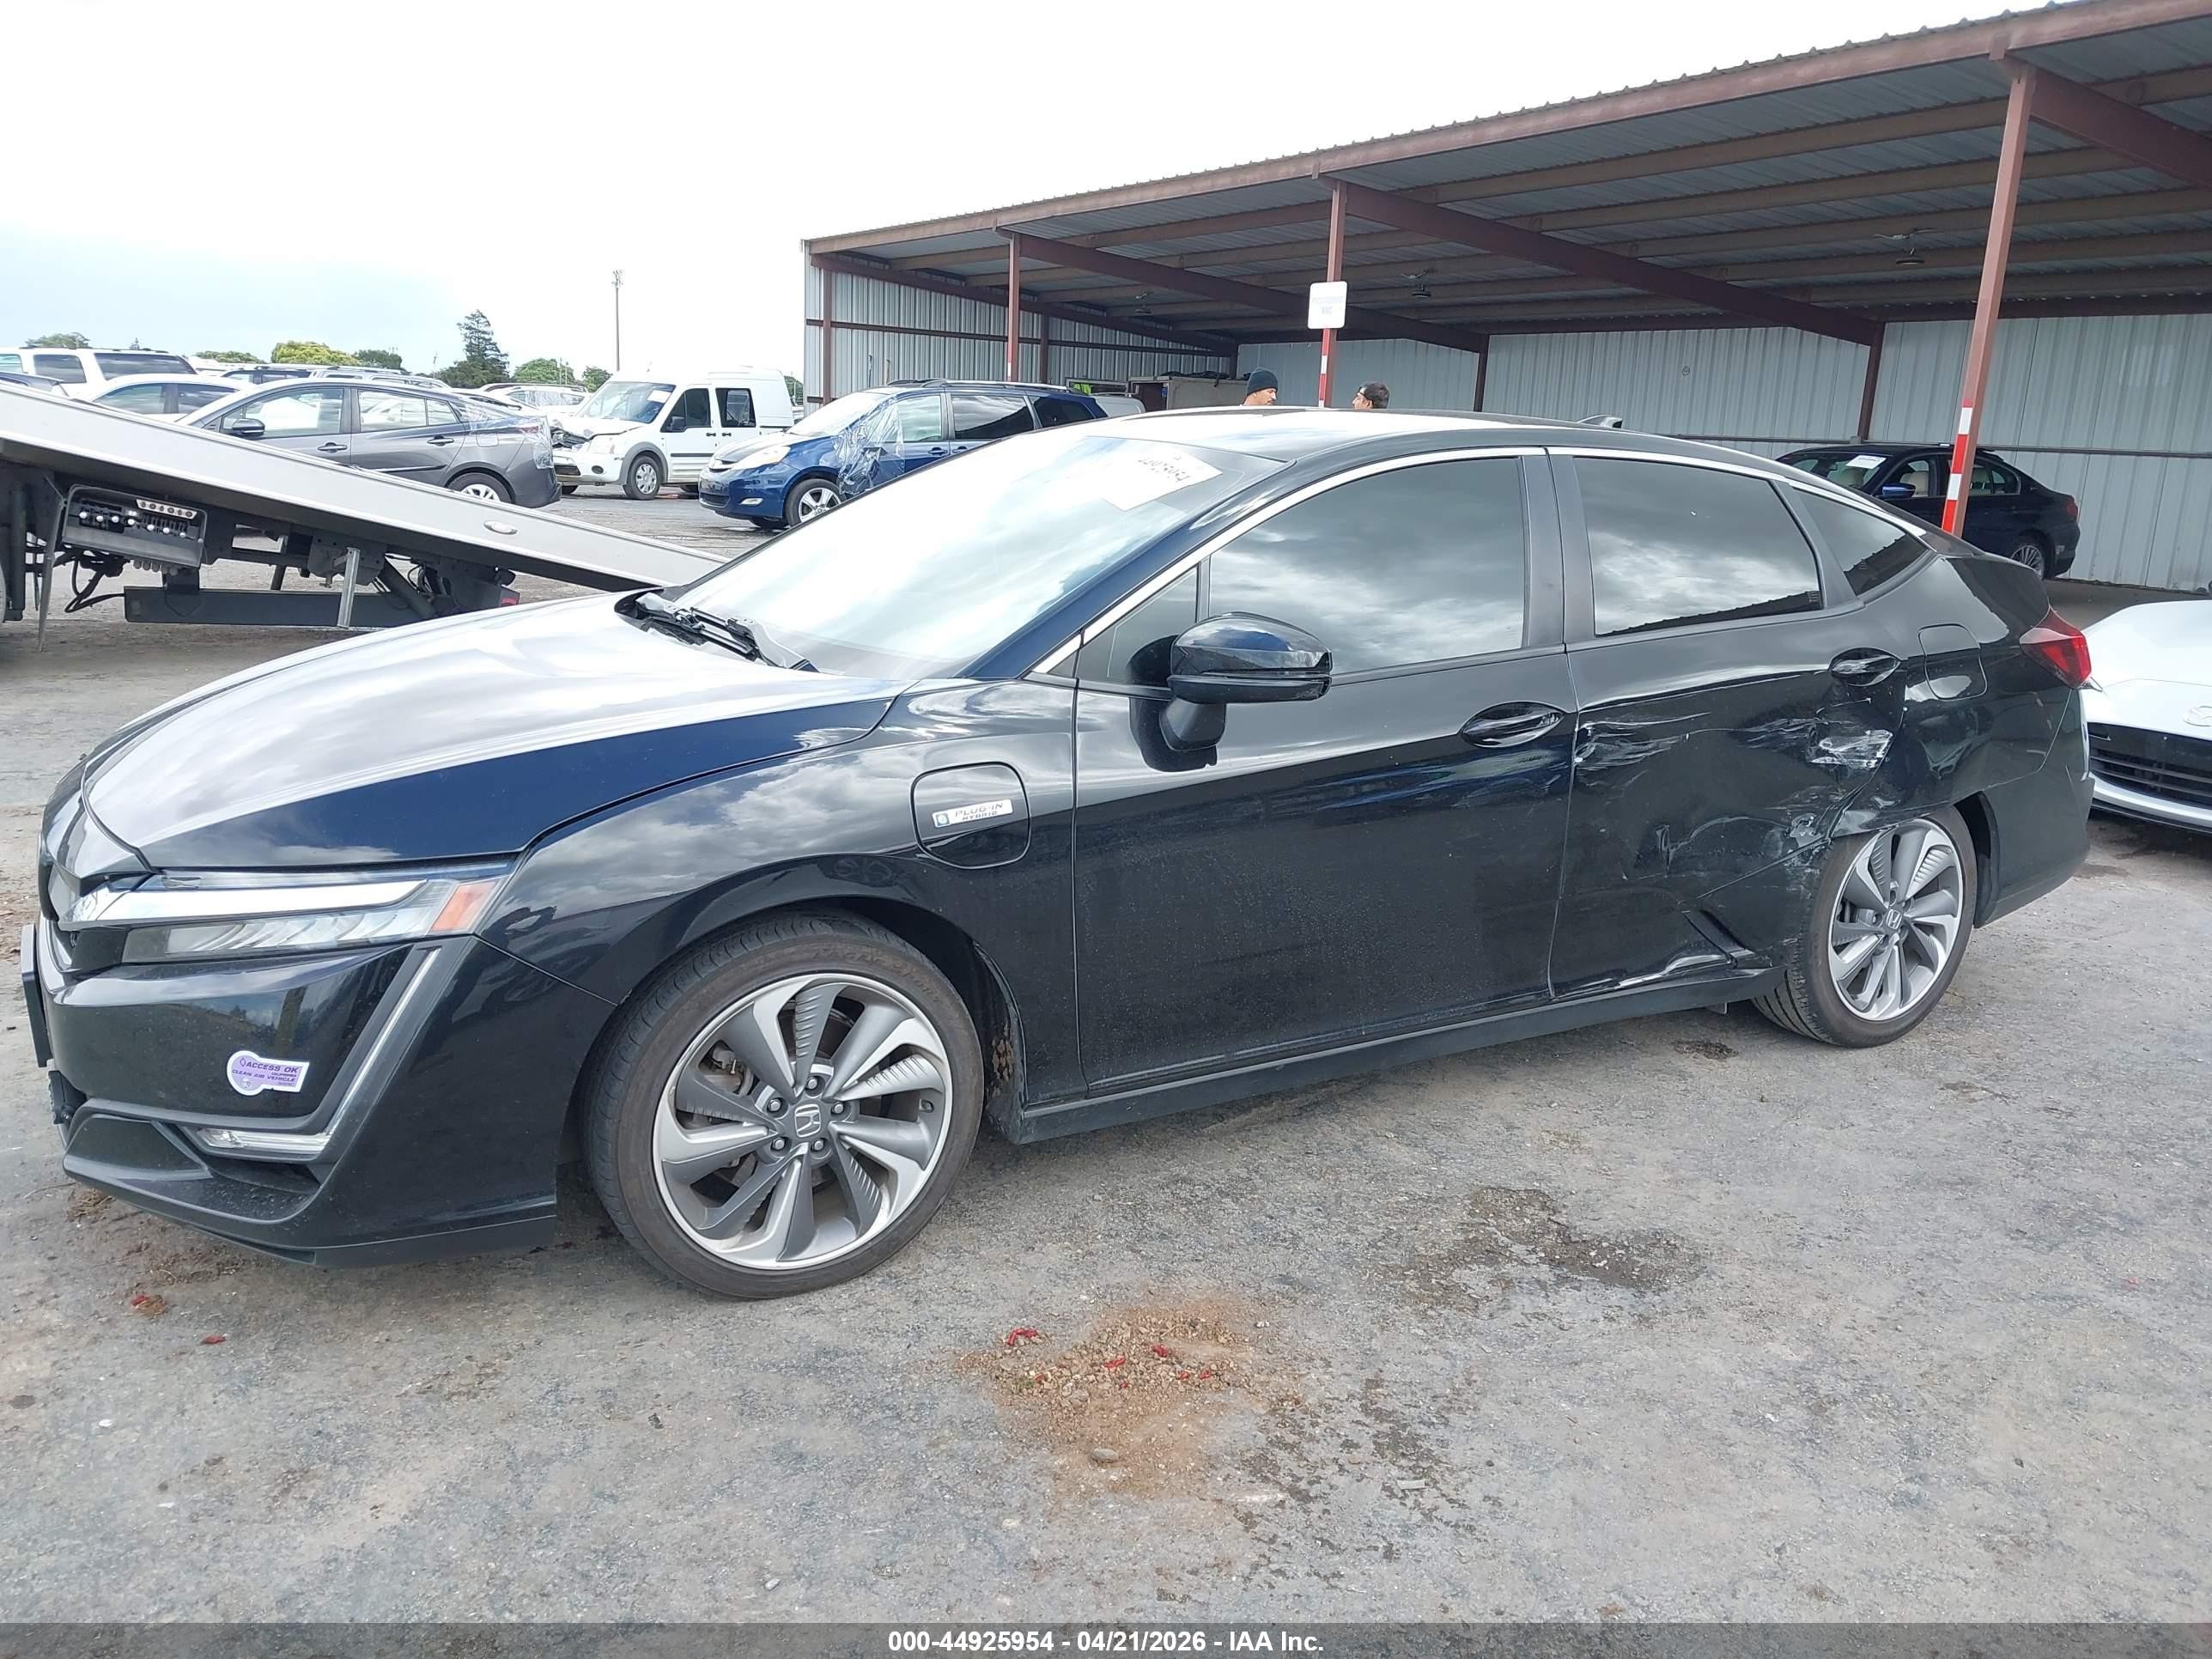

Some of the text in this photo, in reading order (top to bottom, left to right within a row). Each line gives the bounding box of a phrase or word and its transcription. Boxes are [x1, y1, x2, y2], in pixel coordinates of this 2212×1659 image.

[955, 803, 1003, 817] PLUG-IN
[962, 811, 998, 820] HYBRID
[246, 1061, 281, 1072] ACCESS
